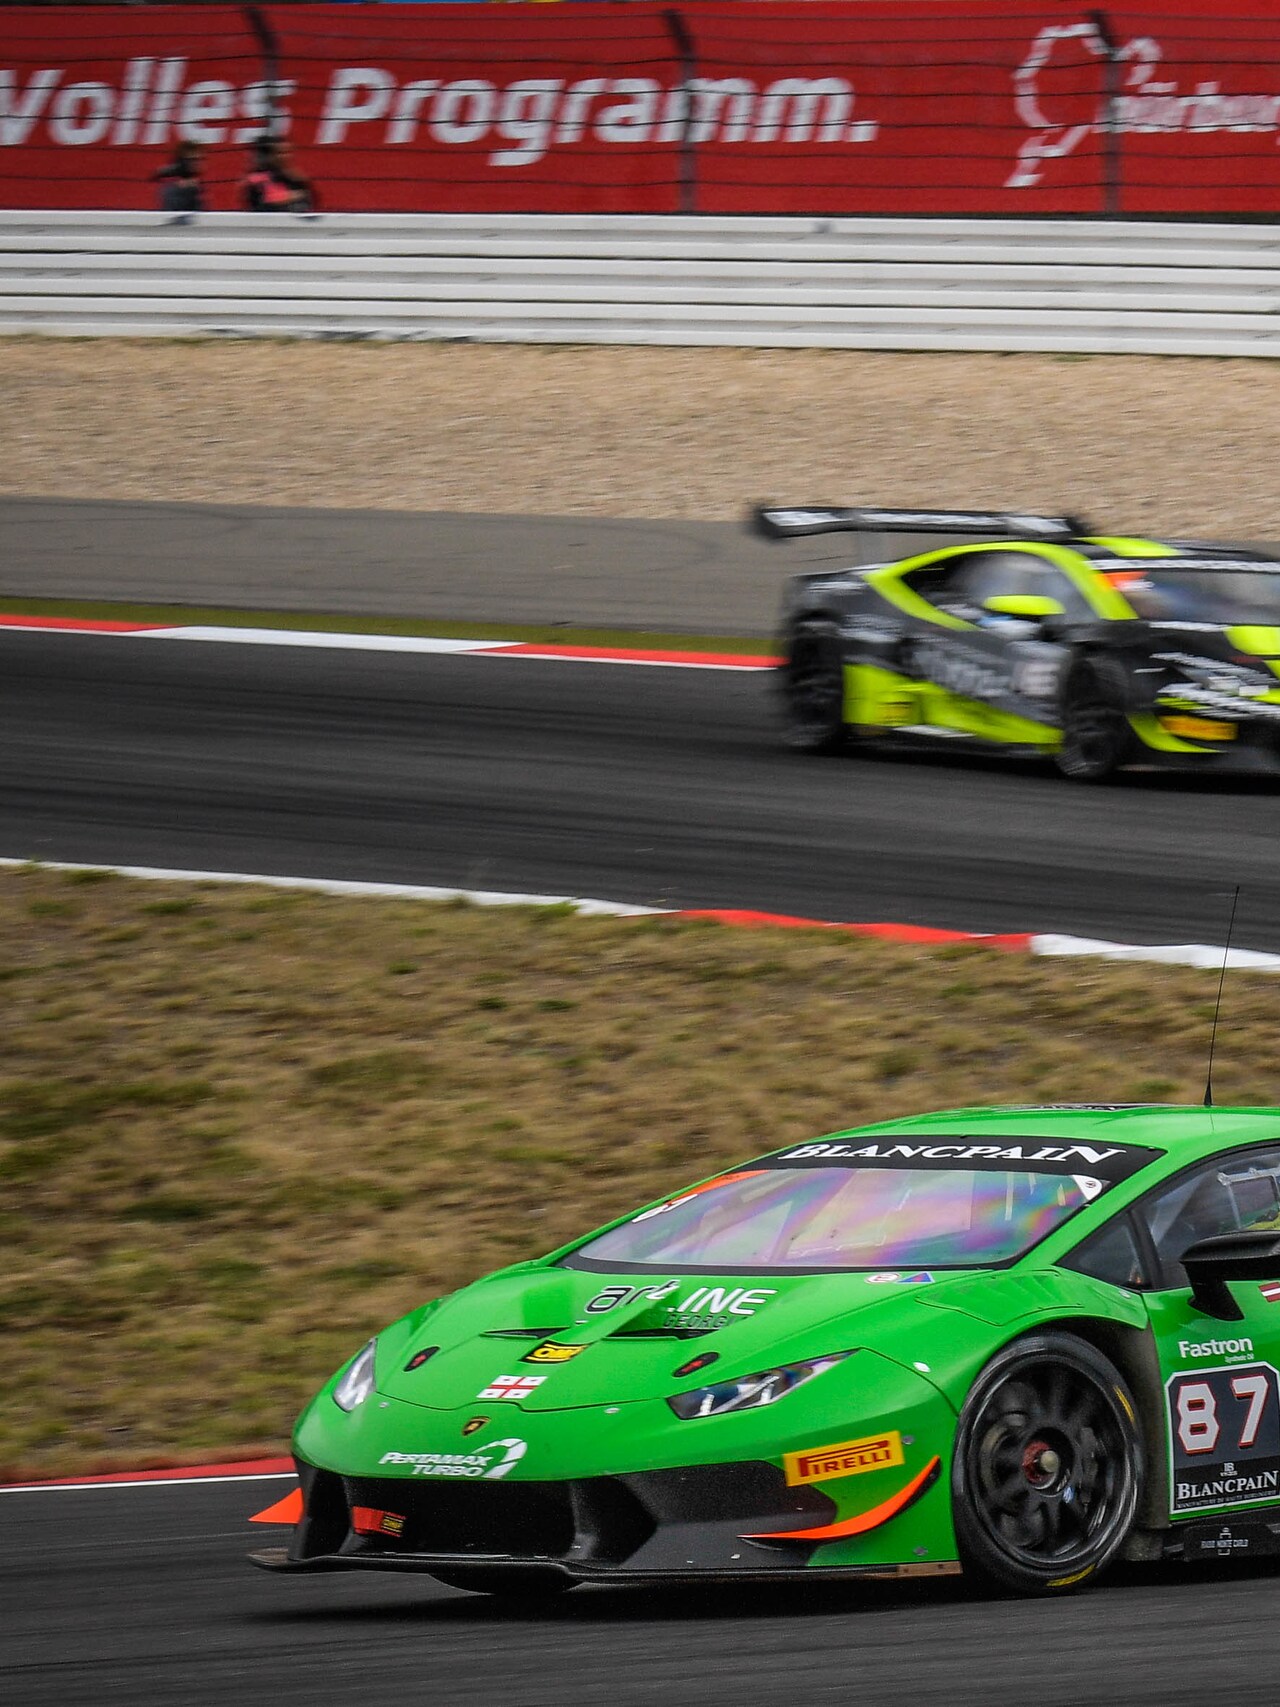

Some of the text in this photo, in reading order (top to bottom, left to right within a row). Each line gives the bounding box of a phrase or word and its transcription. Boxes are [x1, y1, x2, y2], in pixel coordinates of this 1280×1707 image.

[0, 57, 878, 166] Volles Programm.
[778, 1143, 1127, 1165] BLANCPAIN
[1178, 1338, 1254, 1358] Fastron
[1177, 1375, 1268, 1454] 87
[378, 1452, 493, 1467] PERTAMAX
[411, 1464, 485, 1478] TURBO
[797, 1440, 891, 1478] PIRELLI
[1177, 1470, 1279, 1500] BLANCPAIN
